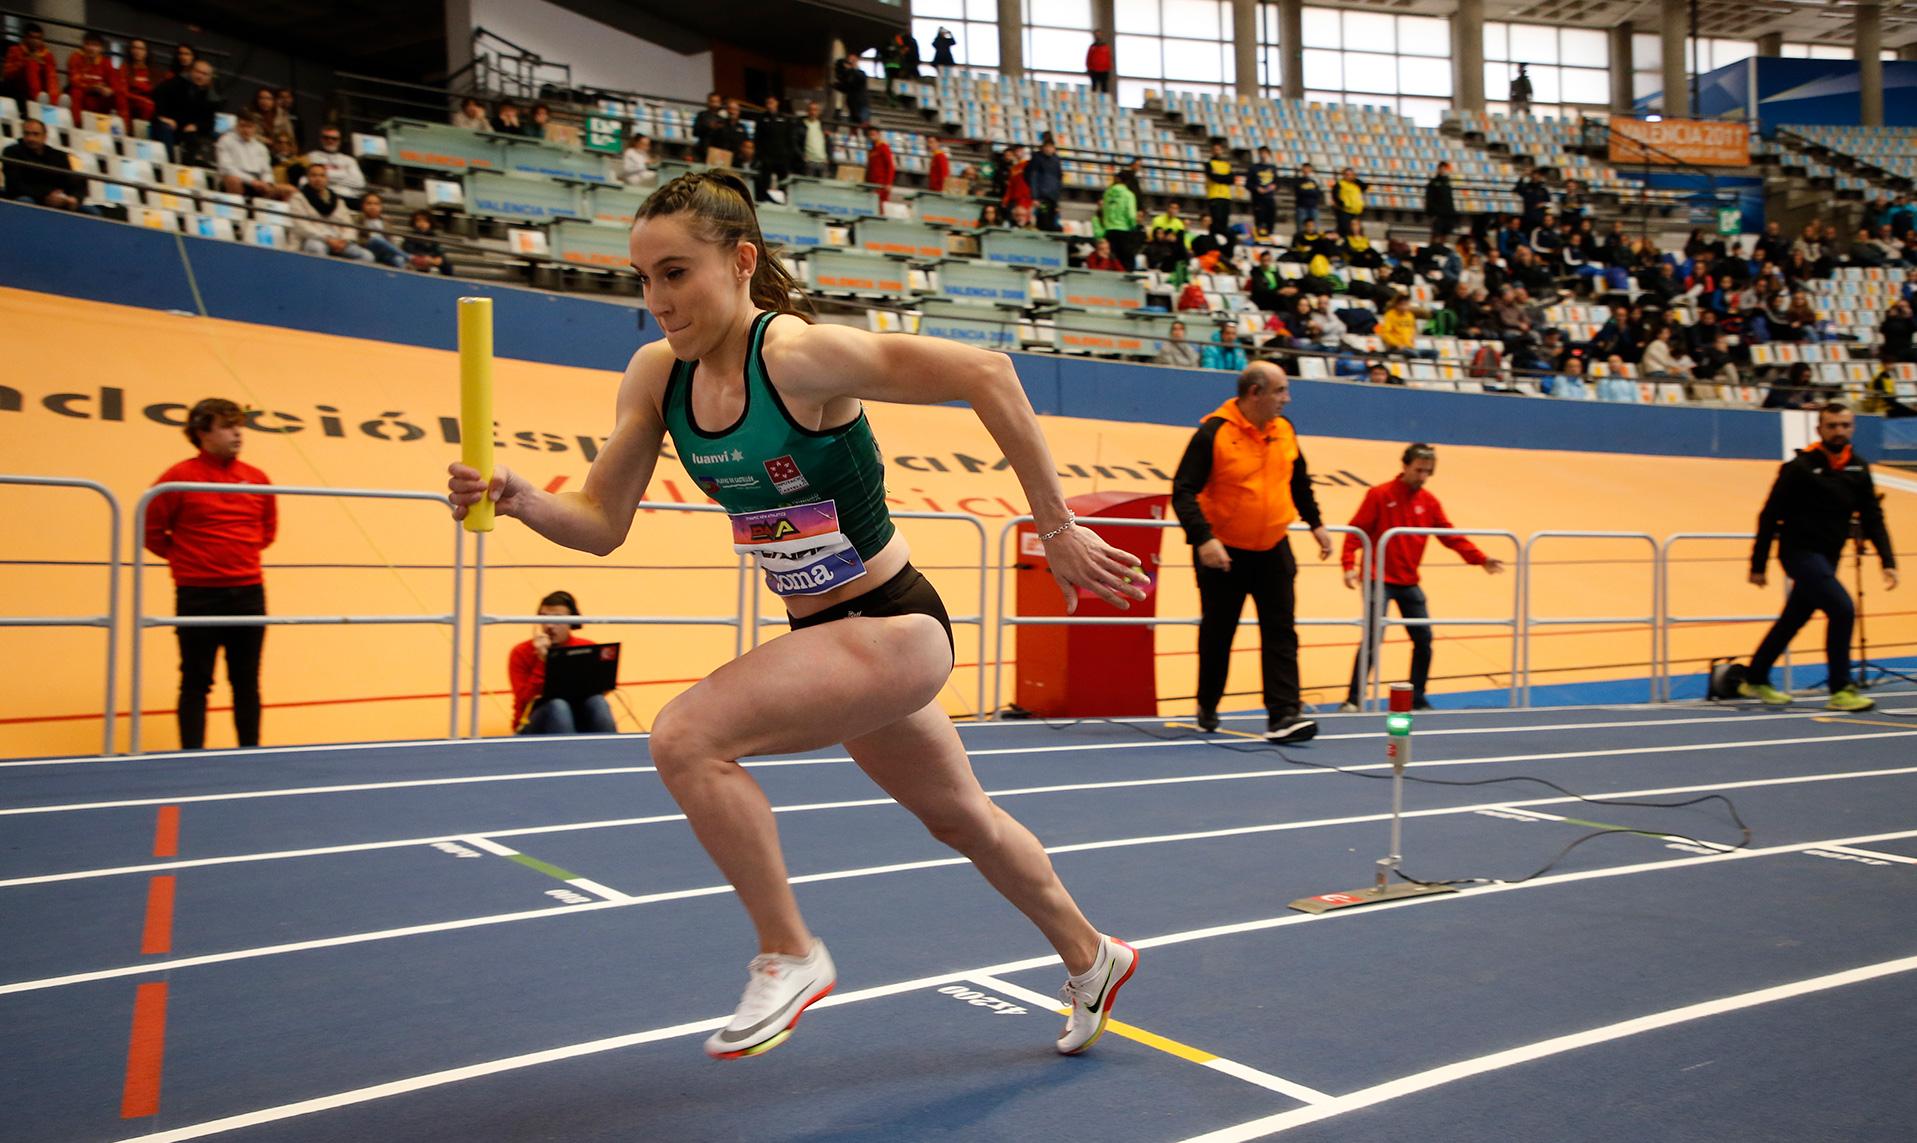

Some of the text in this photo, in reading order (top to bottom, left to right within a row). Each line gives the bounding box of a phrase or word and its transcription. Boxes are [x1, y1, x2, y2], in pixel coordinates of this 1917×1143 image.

[476, 198, 545, 217] VALENCIA
[990, 252, 1037, 265] VALENCIA
[943, 284, 998, 299] VALENCIA
[1066, 294, 1116, 308] VALENCIA
[927, 325, 986, 342] VALENCIA
[1062, 333, 1113, 348] VALENCIA
[691, 450, 729, 465] luanvi
[776, 564, 834, 593] oma
[936, 985, 1029, 1015] 4x200
